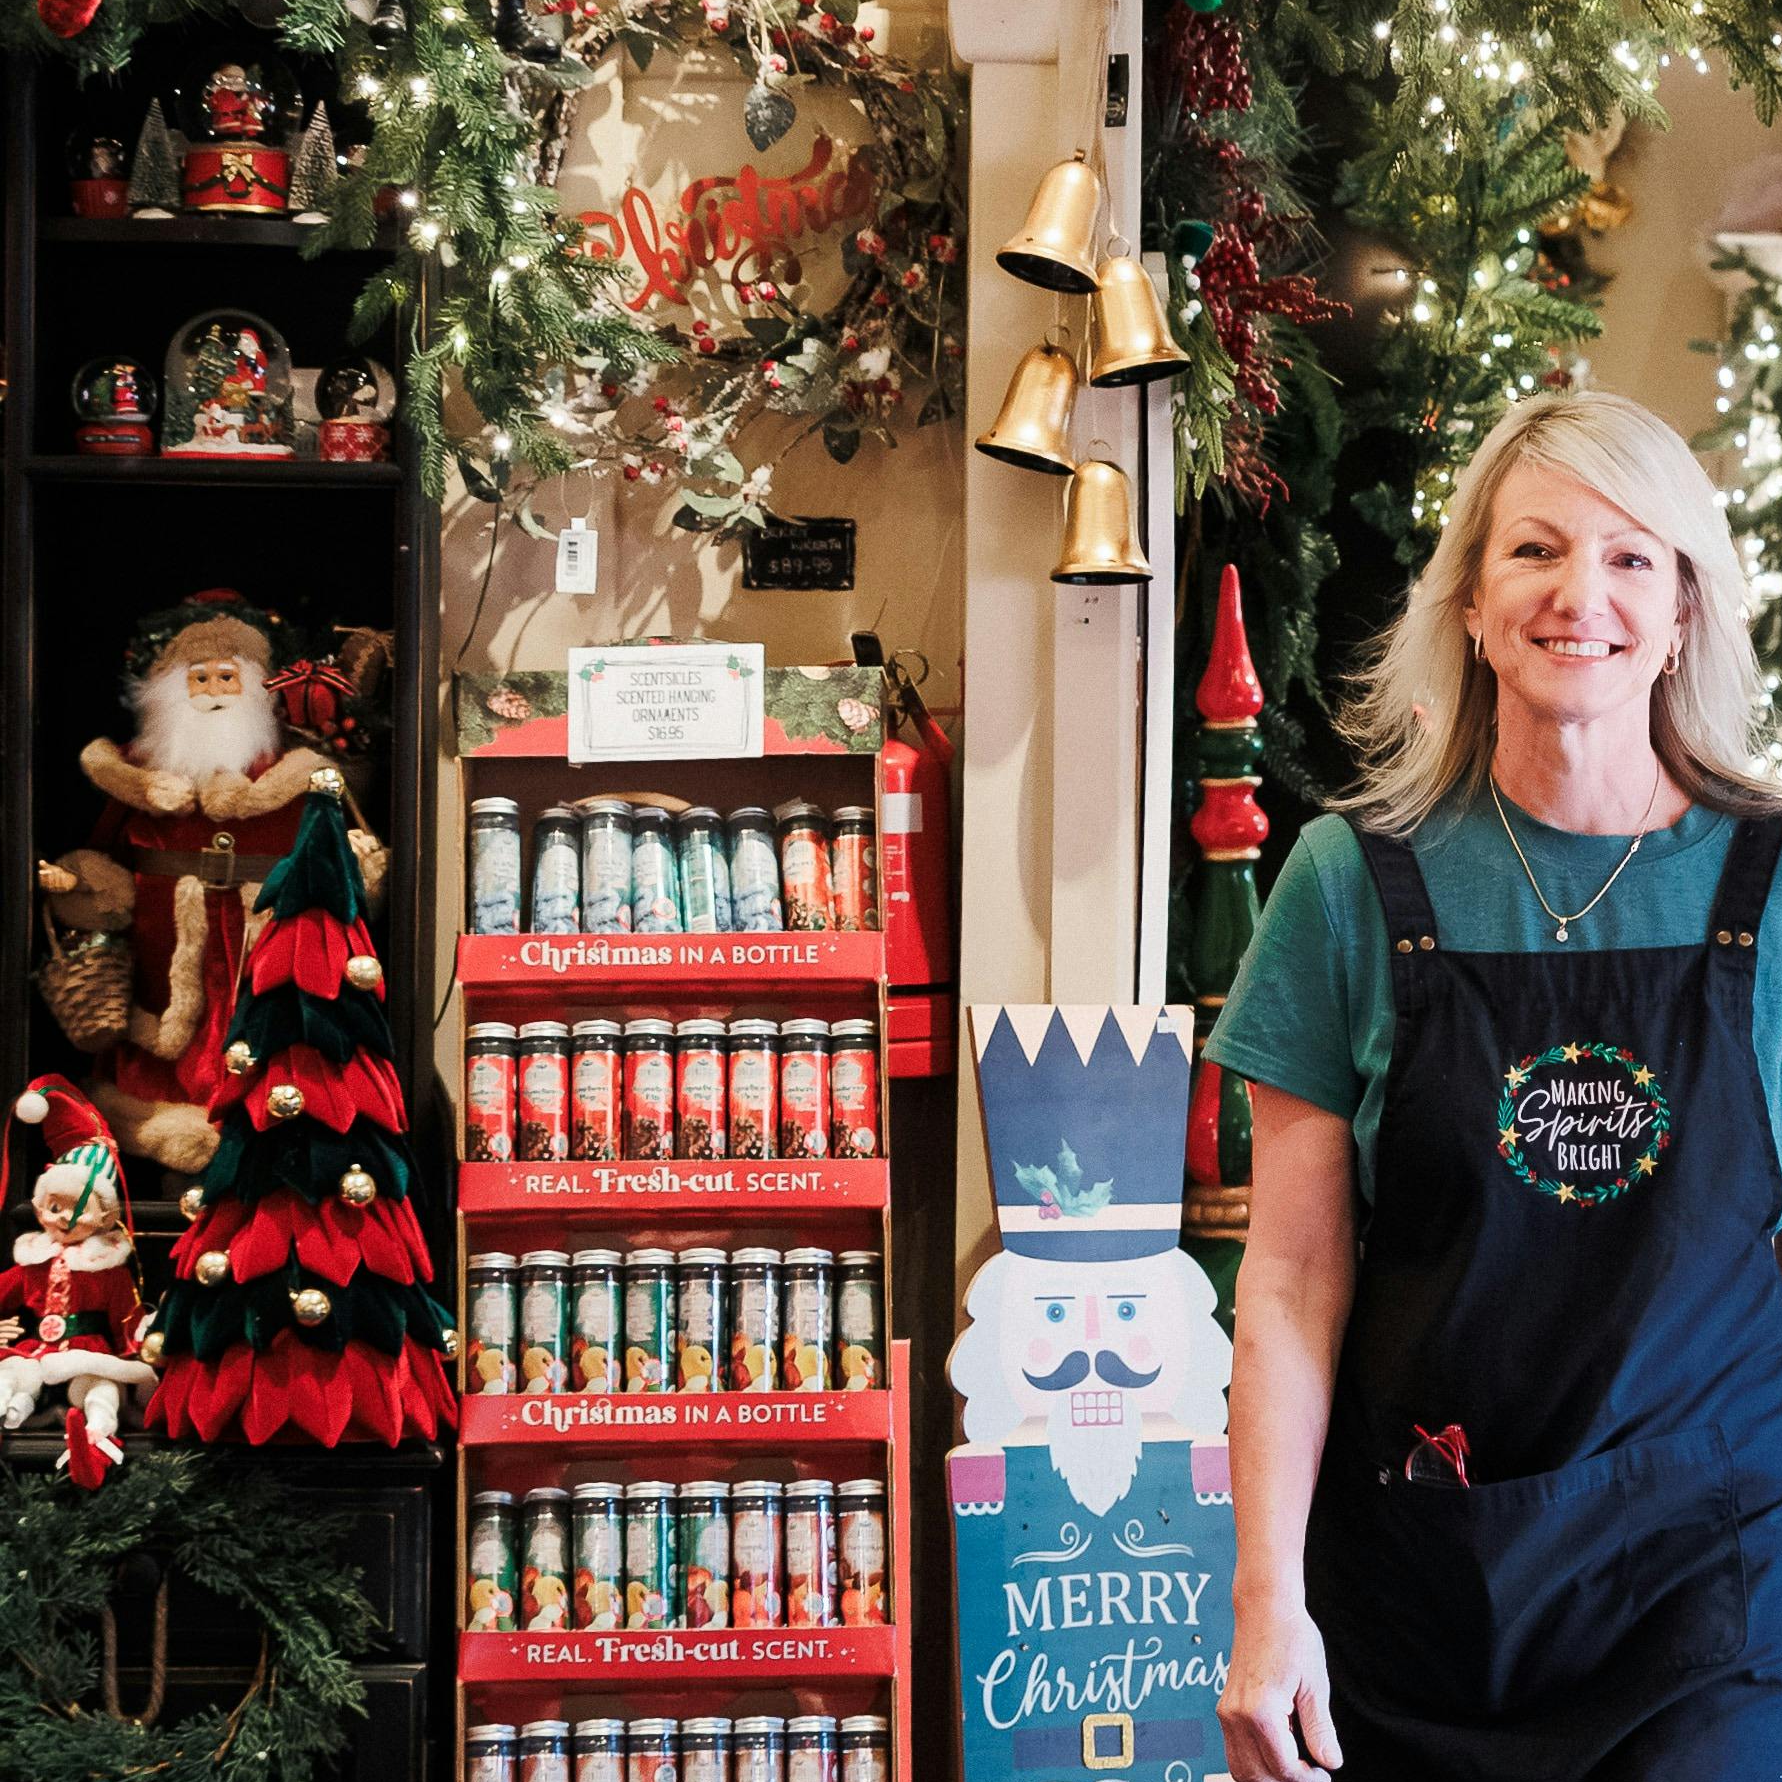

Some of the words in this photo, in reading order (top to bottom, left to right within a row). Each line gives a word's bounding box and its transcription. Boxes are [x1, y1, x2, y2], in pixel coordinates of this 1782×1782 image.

[630, 671, 702, 687] SCENTSICLES
[616, 690, 666, 705] SCENTED
[668, 689, 717, 704] HANGING
[632, 706, 700, 723] ORNAMENTS
[520, 939, 673, 974] Christmas
[679, 946, 703, 965] IN
[708, 946, 727, 965] A
[733, 944, 819, 965] BOTTLE
[1550, 1078, 1625, 1108] MAKING
[1517, 1089, 1654, 1152] Spirits
[1557, 1141, 1621, 1171] BRIGHT
[525, 1174, 591, 1195] REAL.
[746, 1172, 826, 1193] SCENT.
[521, 1398, 678, 1433] Christmas
[684, 1405, 709, 1424] IN
[714, 1405, 733, 1424] A
[738, 1403, 827, 1424] BOTTLE
[1002, 1570, 1212, 1637] MERRY
[526, 1643, 593, 1664] REAL.
[752, 1640, 834, 1661] SCENT.
[976, 1636, 1232, 1730] Christmas
